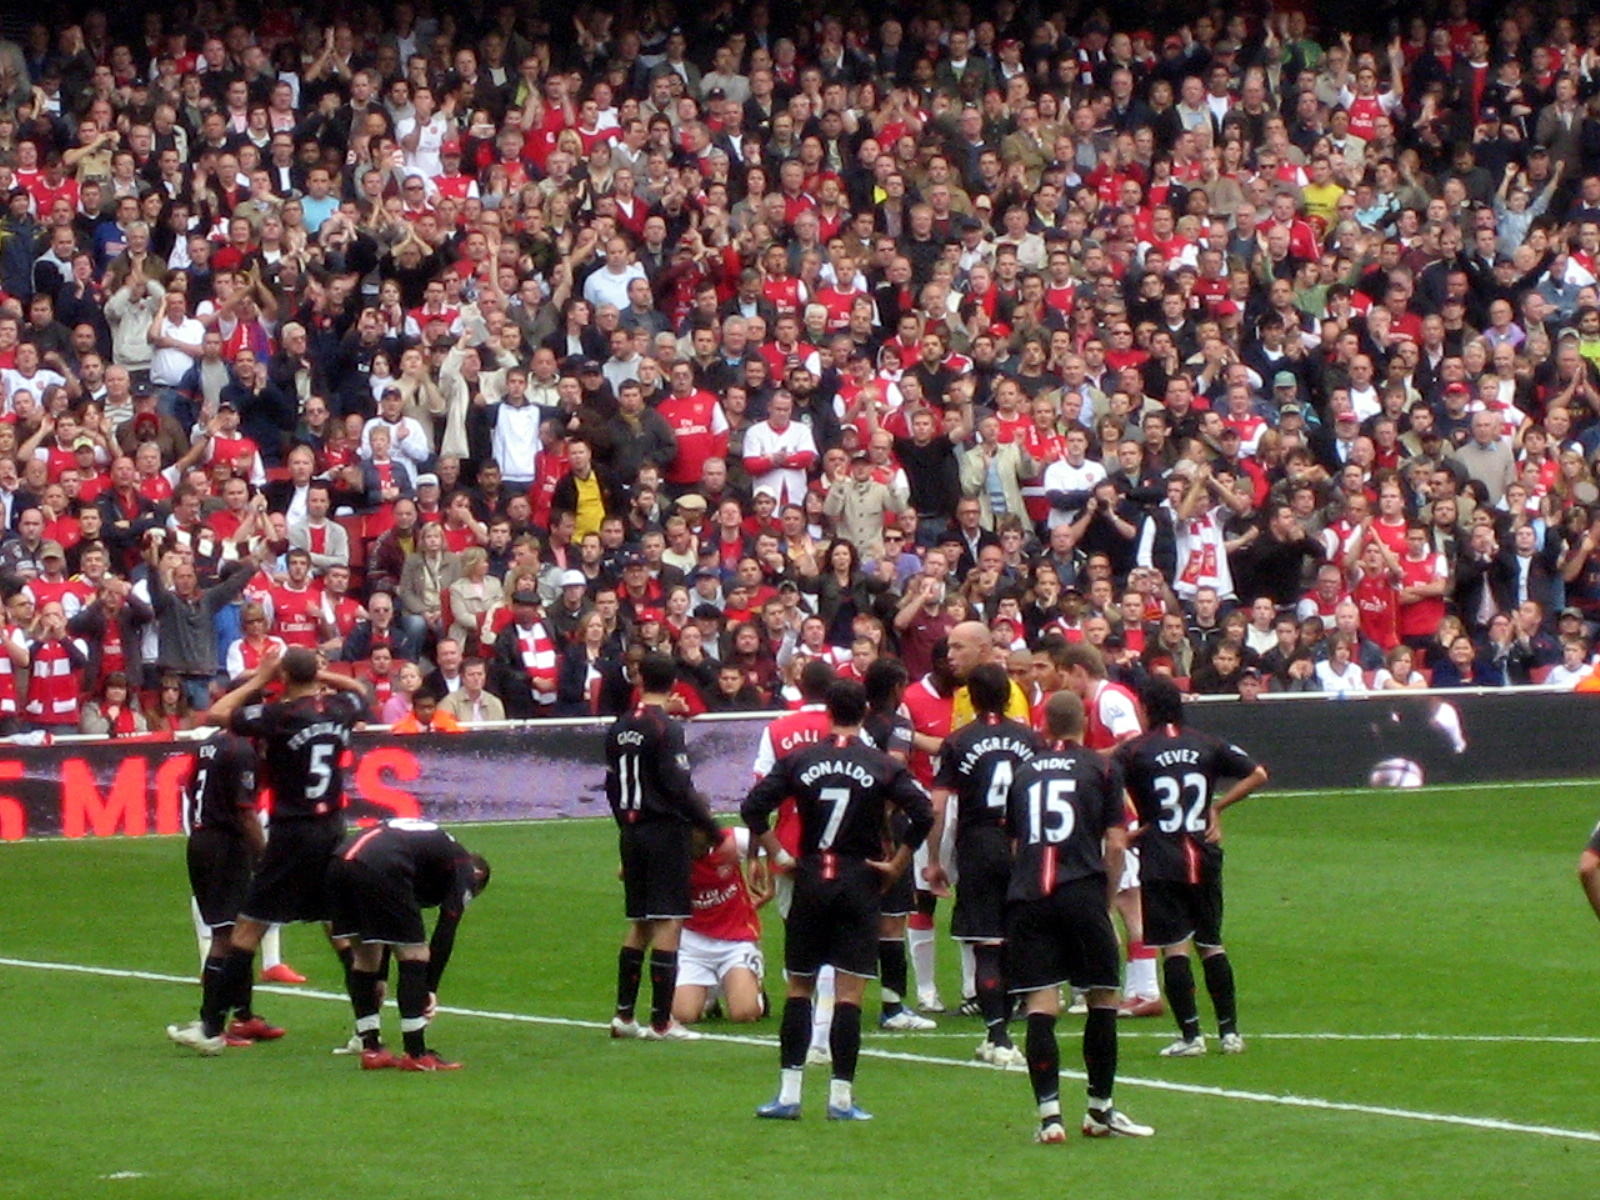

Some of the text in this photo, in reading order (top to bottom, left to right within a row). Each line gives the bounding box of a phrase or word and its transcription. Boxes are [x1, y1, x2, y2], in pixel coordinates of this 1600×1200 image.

[304, 743, 335, 799] 5
[619, 753, 642, 810] 11
[800, 760, 875, 789] RONALDO
[986, 760, 1013, 808] 4
[1031, 757, 1076, 772] VIDIC
[1155, 748, 1200, 767] TEVEZ
[817, 787, 851, 850] 7
[1028, 779, 1077, 845] 15
[1153, 772, 1207, 833] 32
